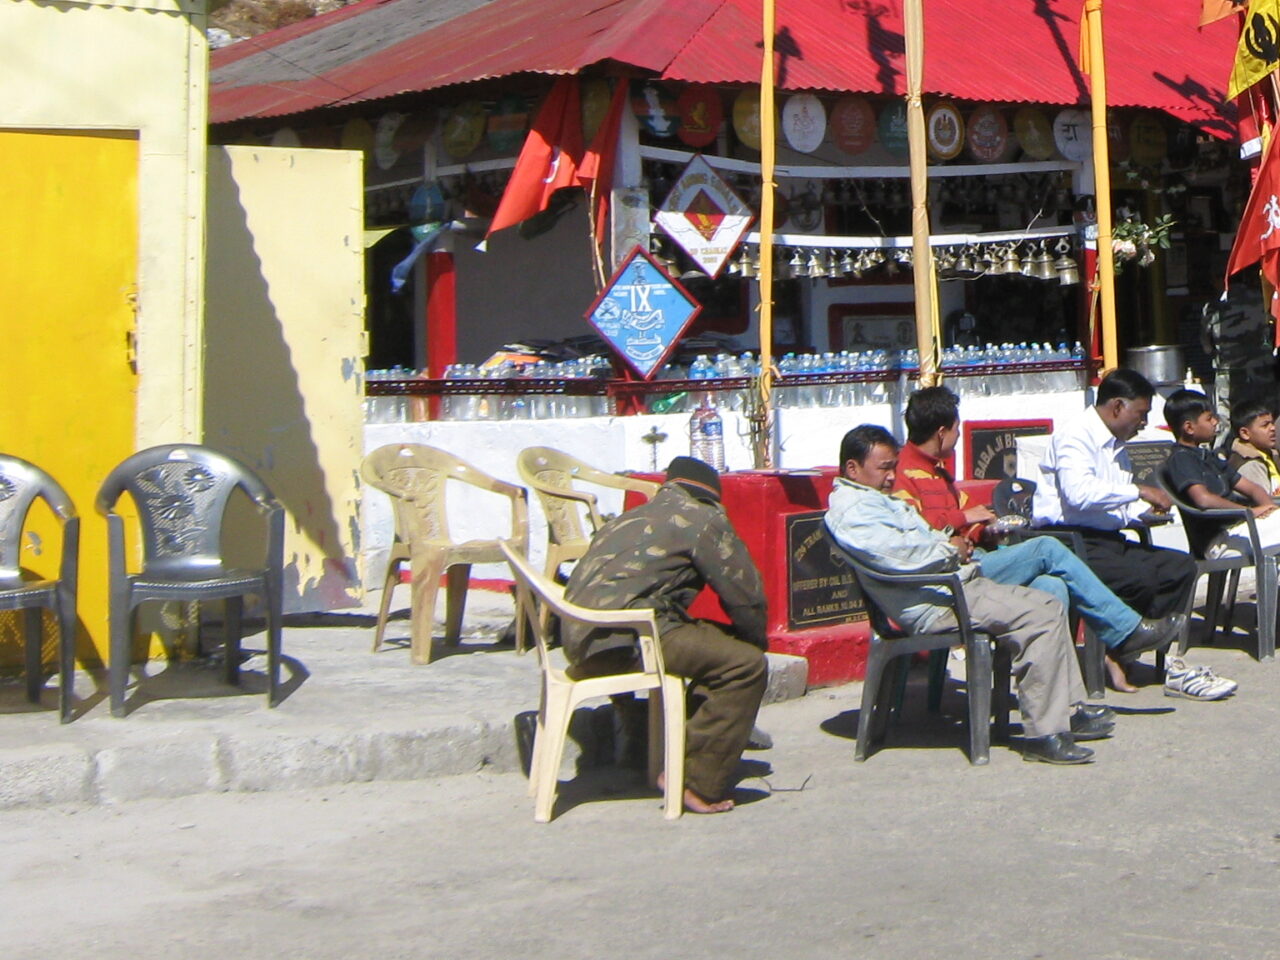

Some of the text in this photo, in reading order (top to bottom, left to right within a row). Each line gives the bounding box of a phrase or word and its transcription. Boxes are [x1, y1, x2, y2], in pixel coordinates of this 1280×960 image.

[631, 285, 653, 312] IX
[974, 444, 995, 478] BABA
[995, 436, 1004, 452] JI
[832, 590, 848, 599] AND
[803, 608, 816, 616] ALL
